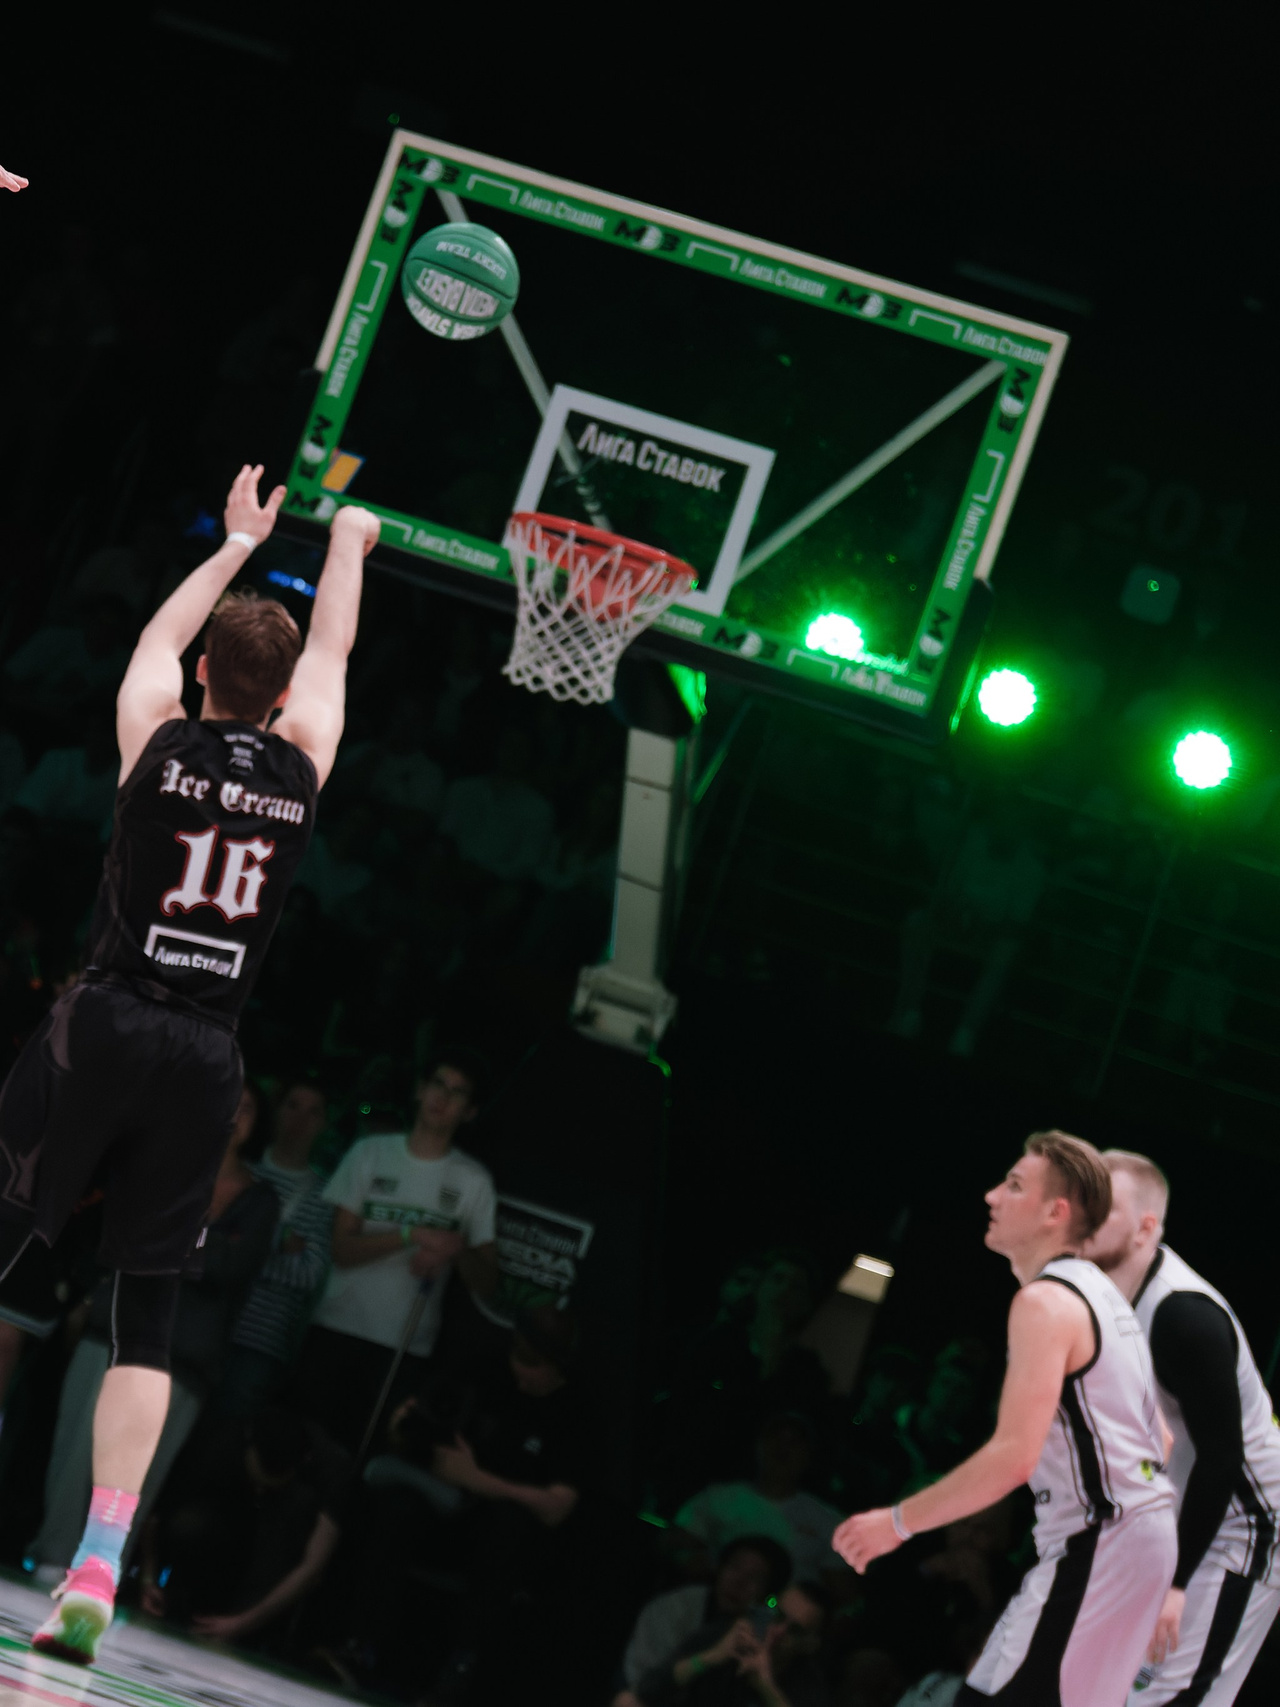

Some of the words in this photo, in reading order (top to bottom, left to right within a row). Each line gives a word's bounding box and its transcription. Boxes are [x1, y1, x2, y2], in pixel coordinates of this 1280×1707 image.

[577, 422, 636, 466] ЛИГА
[636, 440, 727, 493] СТАВОК
[159, 758, 211, 801] Ice
[220, 781, 305, 825] Cream
[160, 824, 276, 924] 16
